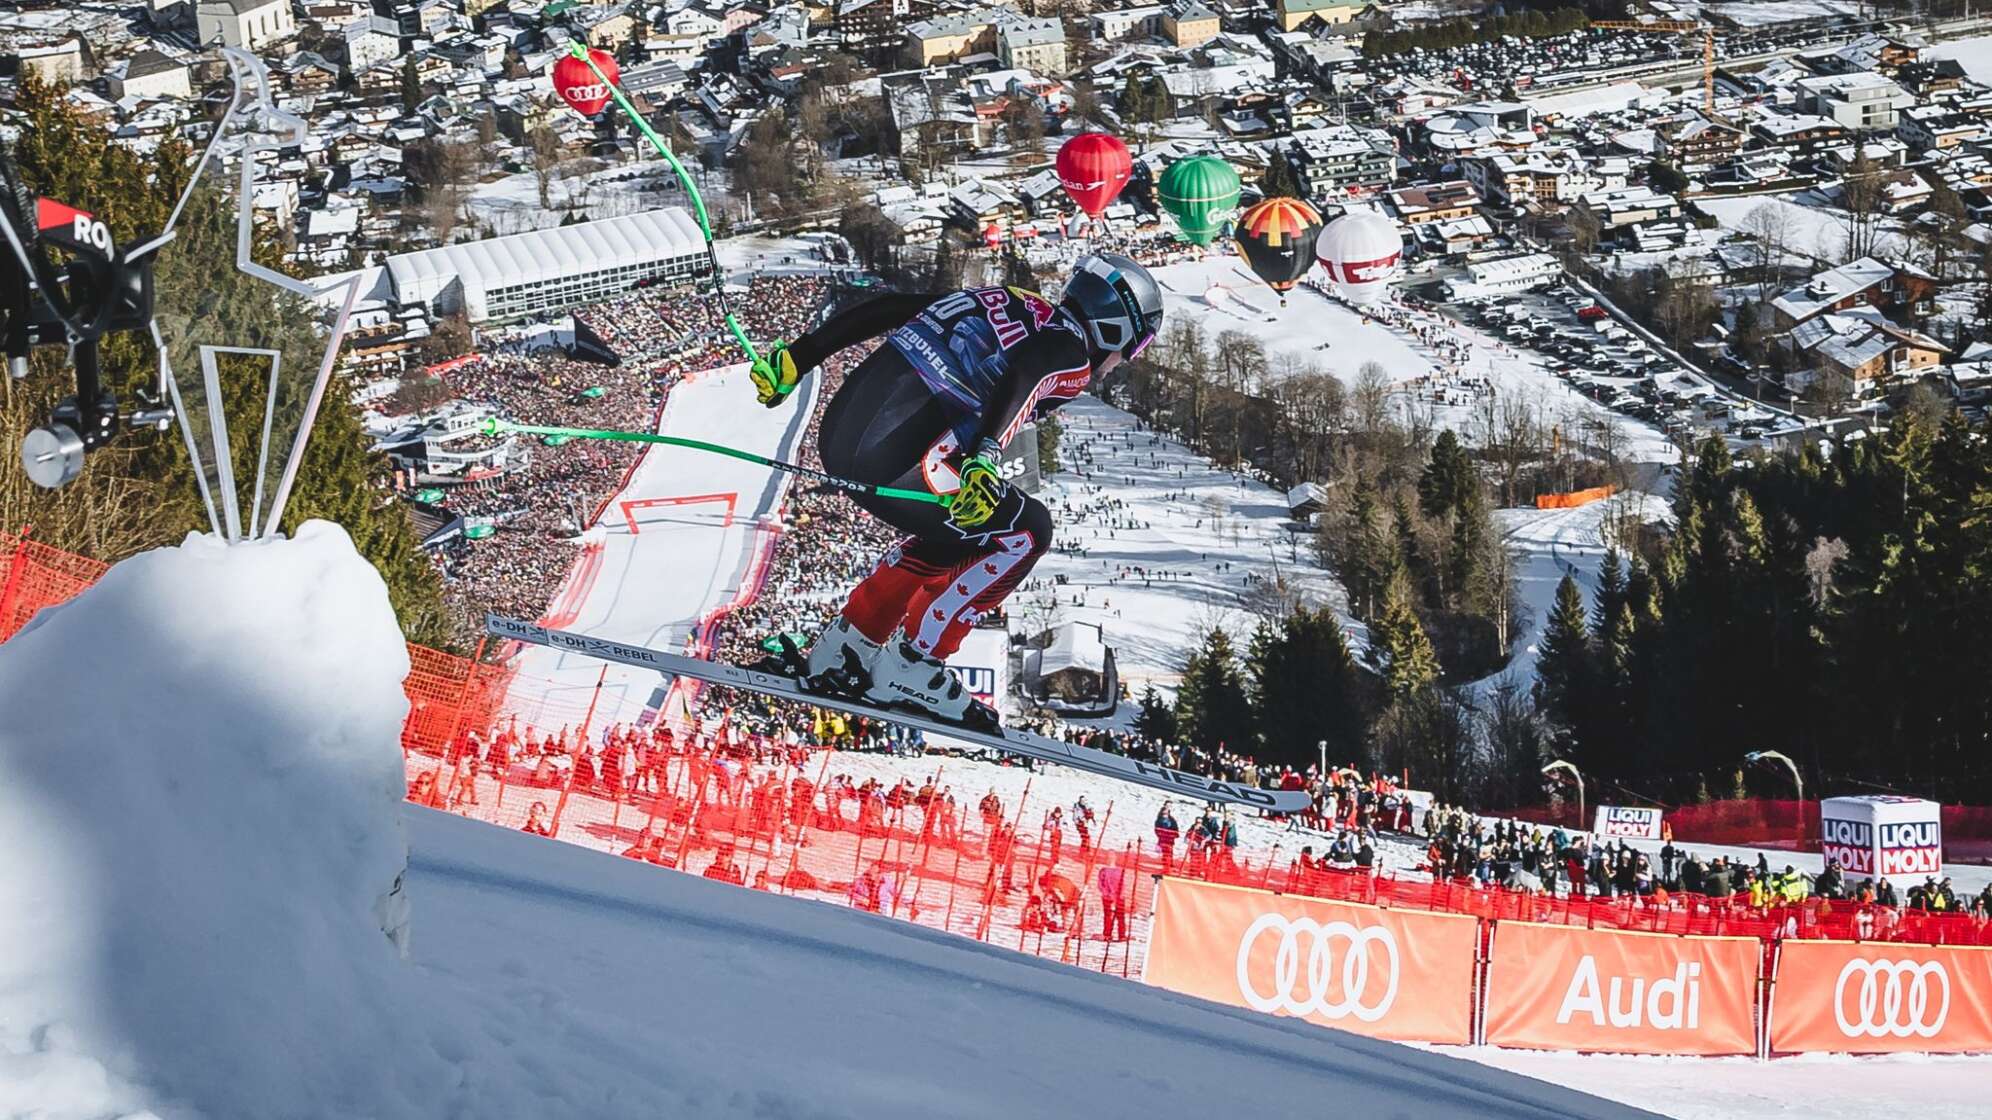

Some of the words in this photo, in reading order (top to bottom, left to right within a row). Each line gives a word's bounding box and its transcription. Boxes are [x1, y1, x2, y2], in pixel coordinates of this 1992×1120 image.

[975, 289, 1029, 351] Bull
[491, 619, 527, 634] e-DH
[551, 633, 586, 649] e-DH
[613, 646, 658, 663] REBEL
[888, 680, 940, 706] HEAD
[1133, 760, 1277, 806] HEAD
[1606, 821, 1650, 837] MOLY
[1608, 809, 1652, 824] LIQUI
[1823, 820, 1872, 847] LIQUI
[1881, 823, 1938, 848] LIQUI
[1824, 845, 1873, 872] MOLY
[1882, 848, 1940, 874] MOLY
[1555, 954, 1701, 1031] Audi
